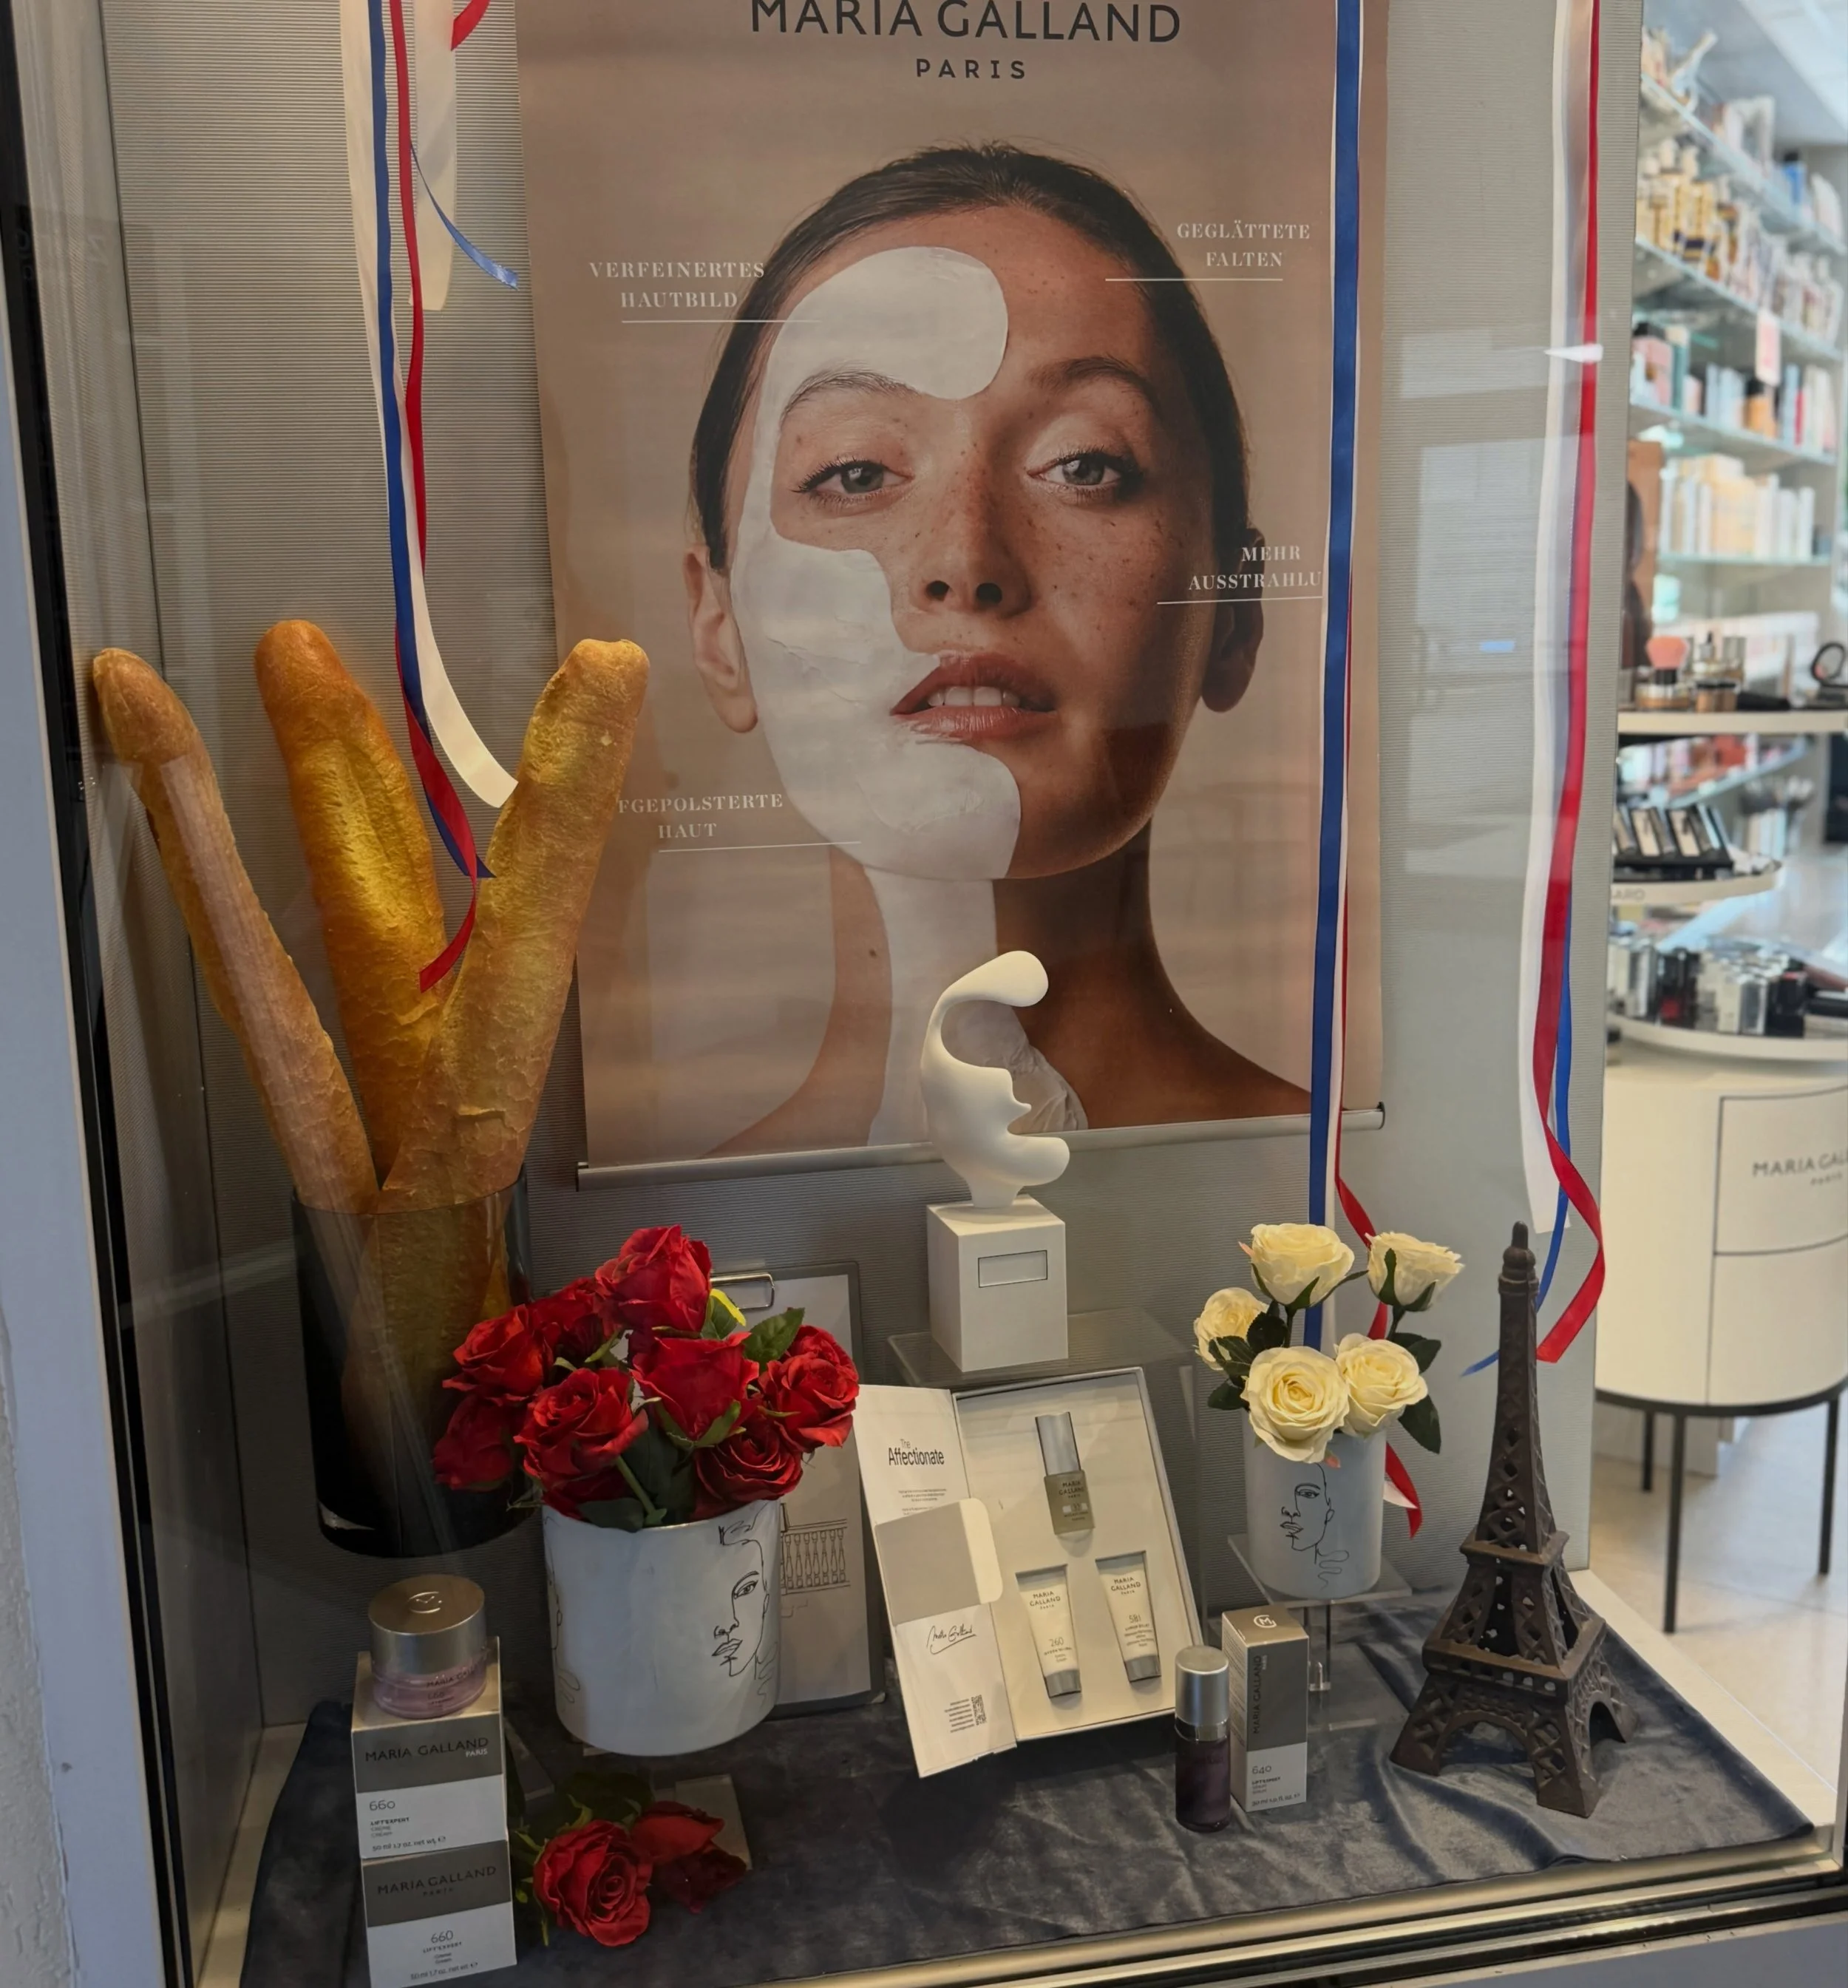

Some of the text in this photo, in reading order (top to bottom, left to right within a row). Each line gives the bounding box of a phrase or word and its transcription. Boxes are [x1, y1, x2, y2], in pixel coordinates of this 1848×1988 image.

[752, 0, 1181, 42] MARIA GALLAND
[915, 58, 1026, 79] PARIS
[1176, 220, 1311, 240] GEGLÄTTETE
[1206, 251, 1283, 267] FALTEN
[589, 261, 765, 278] VERFEINERTES
[620, 291, 738, 308] HAUTBILD
[1241, 546, 1301, 562] MEHR
[1188, 571, 1322, 591] AUSSTRAHLU
[618, 793, 784, 813] FGEPOLSTERTE
[658, 823, 717, 839] HAUT
[1752, 1150, 1848, 1178] MARIA GAL
[900, 1438, 911, 1449] The
[889, 1447, 945, 1466] Affectionate
[1110, 1581, 1141, 1592] GALLAND
[1113, 1576, 1135, 1585] MARIA
[1029, 1595, 1061, 1607] GALLAND
[1033, 1590, 1055, 1599] MARIA
[1047, 1636, 1064, 1647] 260
[1253, 1655, 1263, 1734] MARIA GALLAND
[365, 1737, 489, 1762] MARIA GALLAND
[465, 1748, 489, 1758] PARIS
[1251, 1765, 1272, 1775] 640
[369, 1799, 395, 1811] 660
[372, 1844, 382, 1853] 50
[382, 1842, 393, 1850] ml
[413, 1839, 426, 1847] net
[377, 1865, 497, 1896] MARIA GALLAND
[430, 1930, 455, 1944] 660
